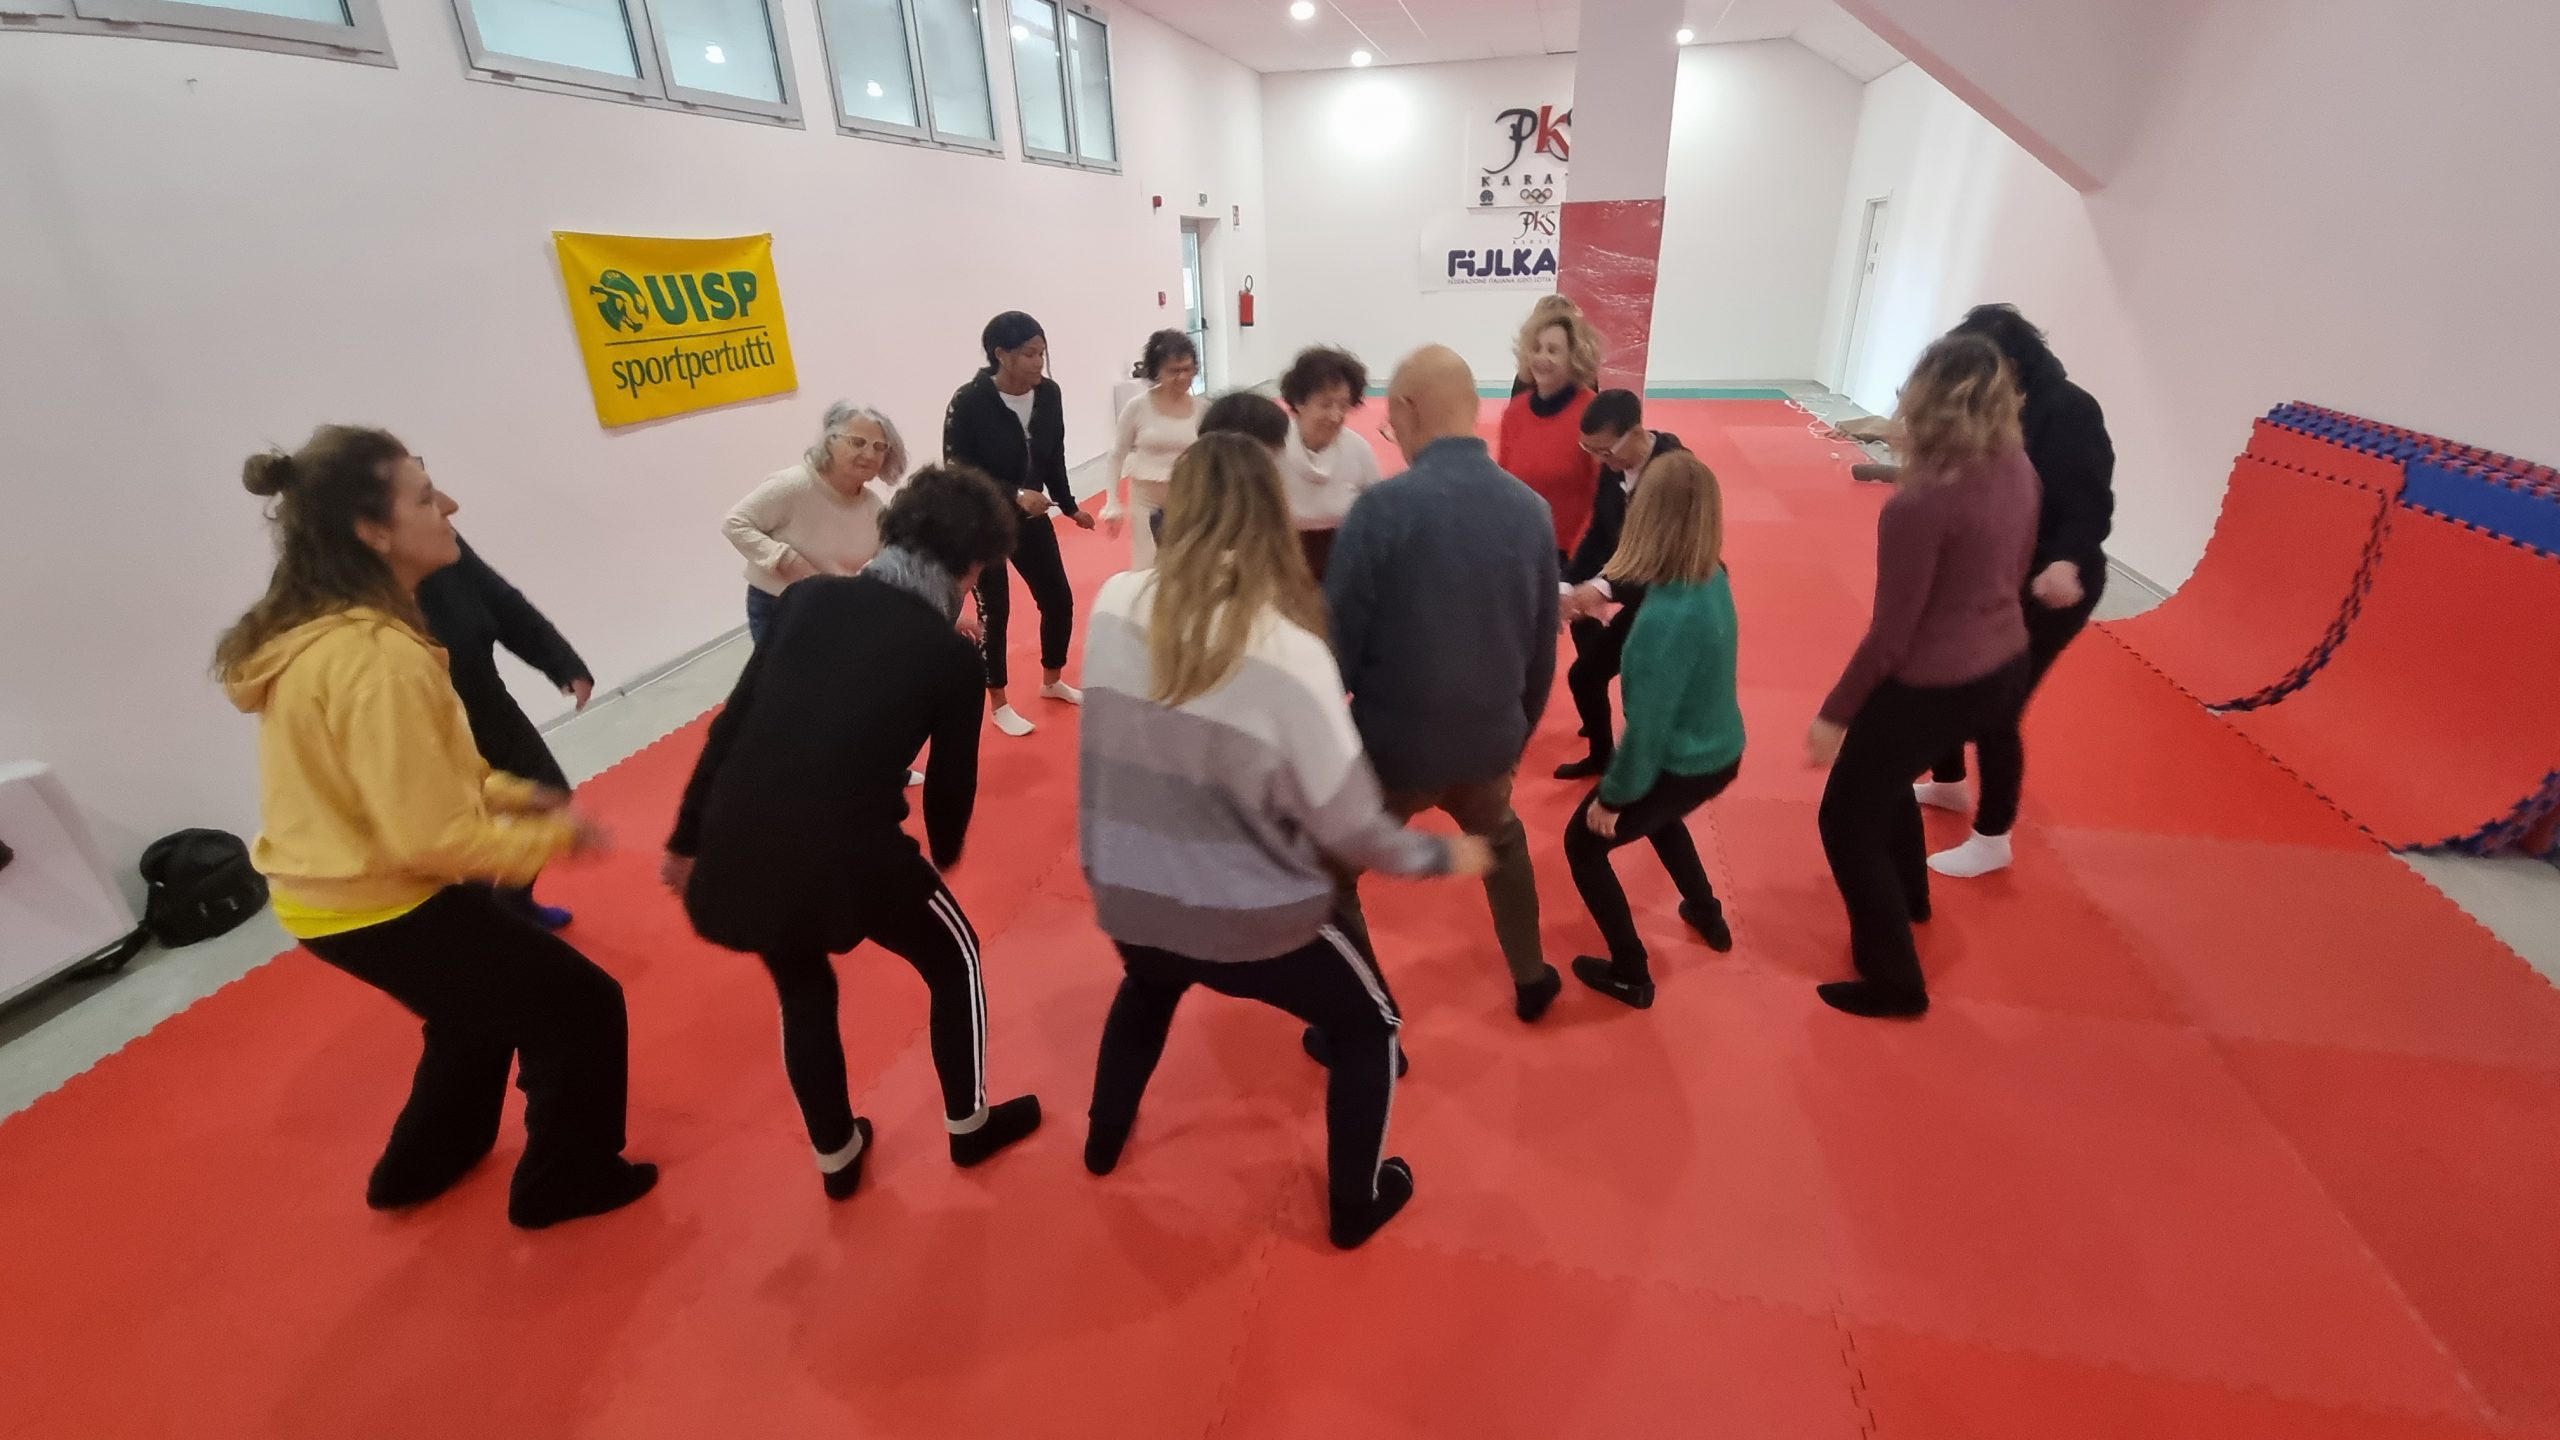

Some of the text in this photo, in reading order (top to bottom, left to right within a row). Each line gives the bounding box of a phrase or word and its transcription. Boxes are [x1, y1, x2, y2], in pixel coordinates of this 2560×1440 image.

[1482, 105, 1573, 174] PK
[1481, 173, 1568, 187] KARA
[1513, 210, 1556, 240] PKS
[644, 271, 757, 326] UISP
[612, 331, 776, 399] sportpertutti
